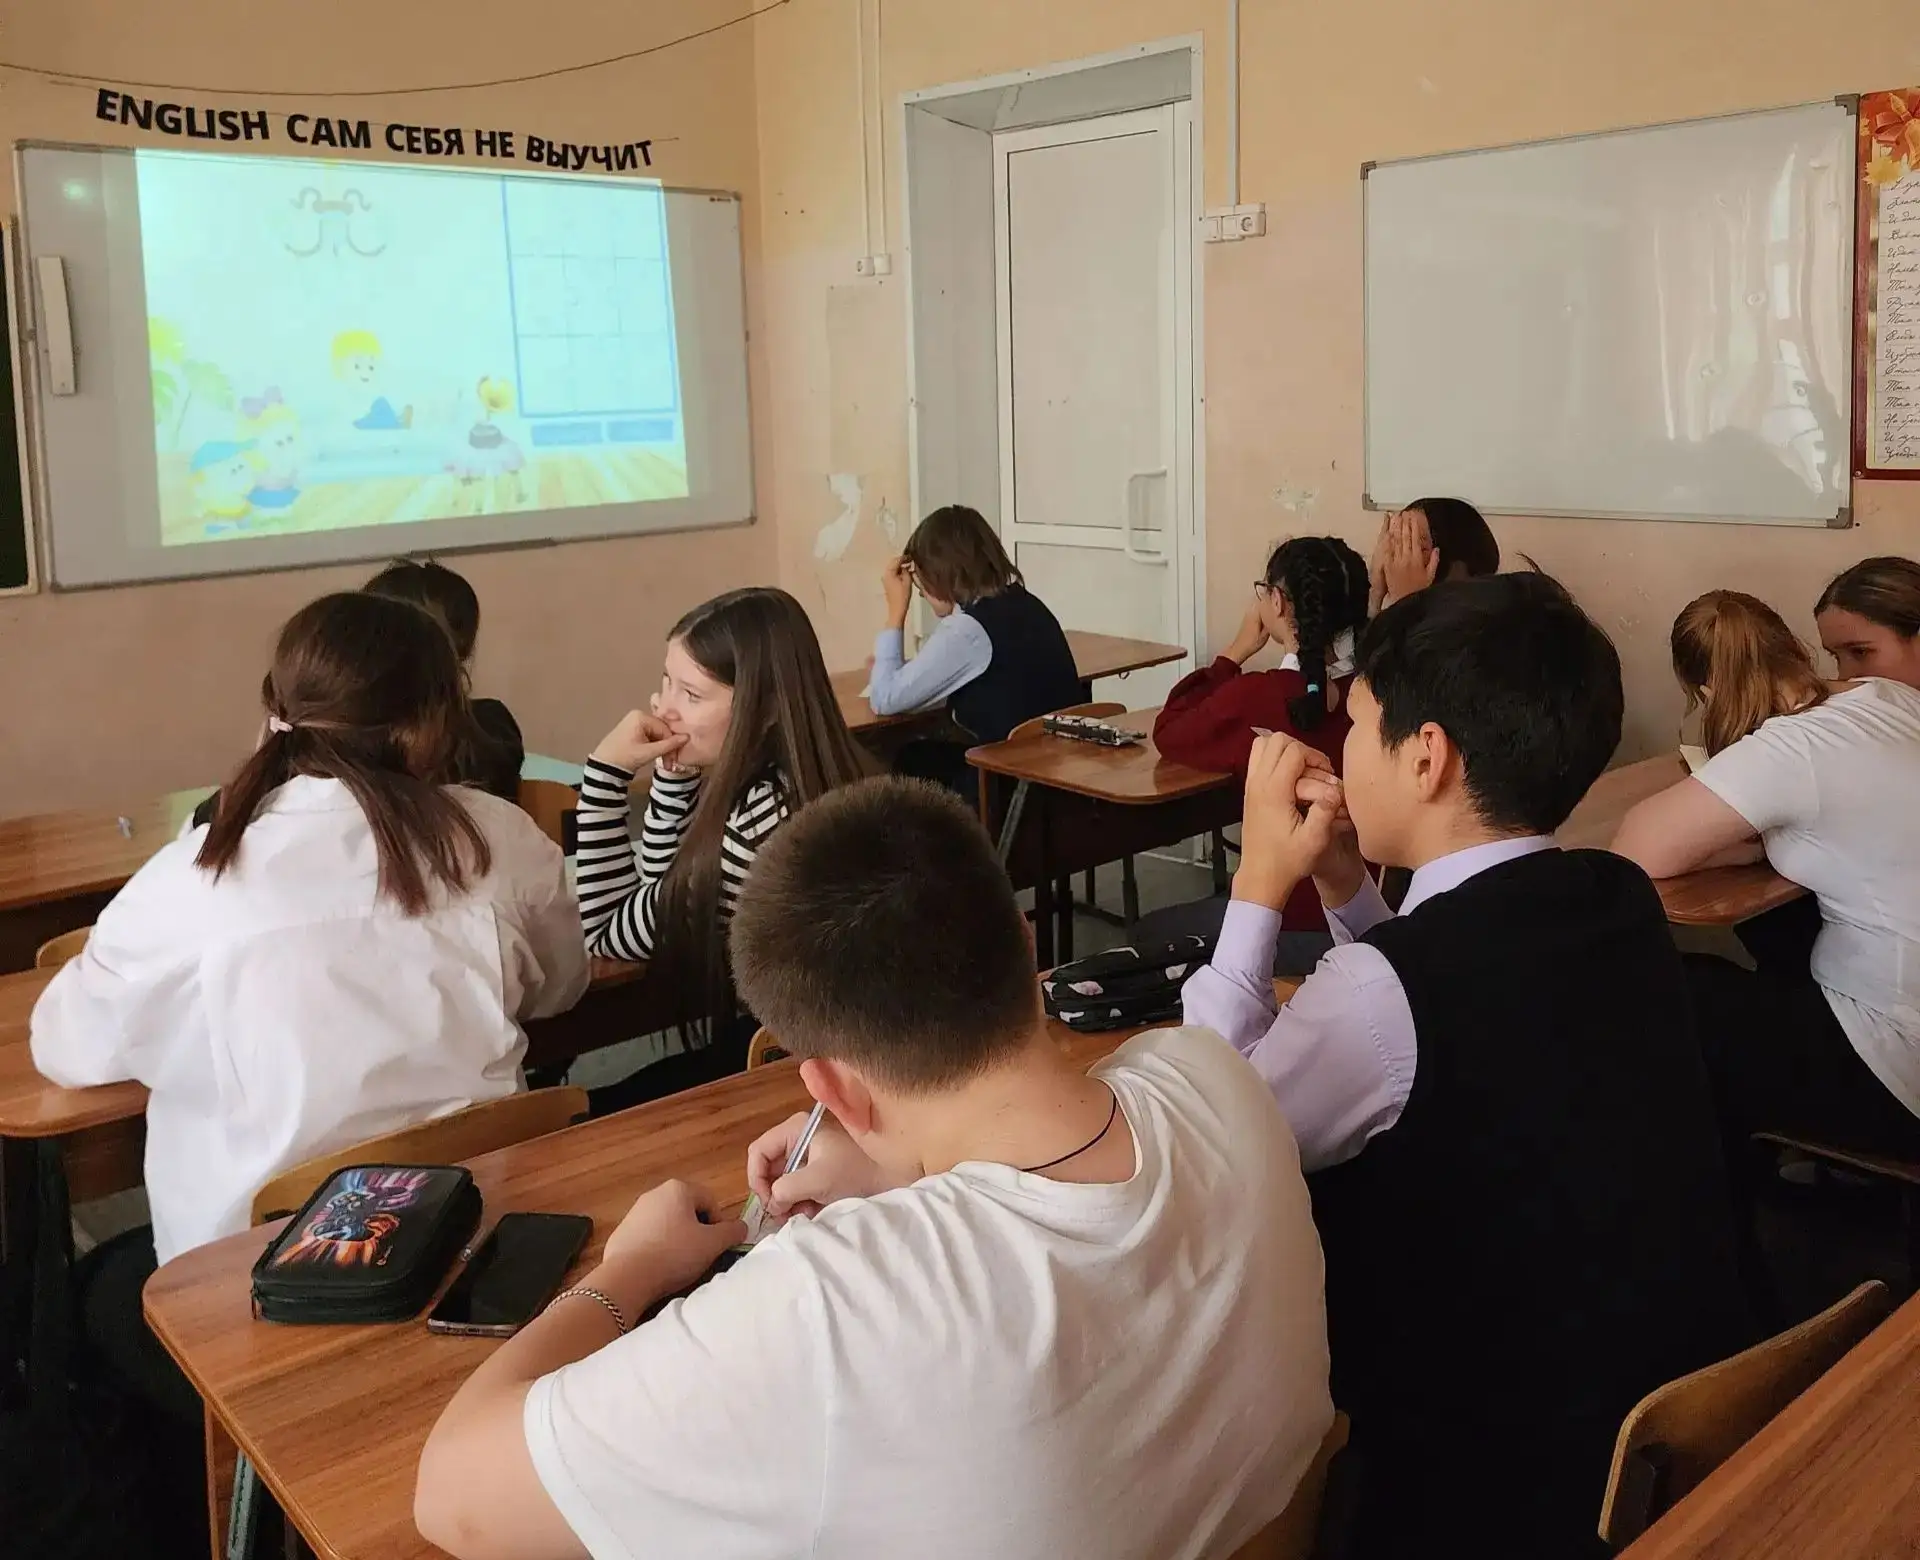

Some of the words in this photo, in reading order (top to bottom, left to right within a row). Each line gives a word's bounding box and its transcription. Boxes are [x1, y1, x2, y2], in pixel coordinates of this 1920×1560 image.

[96, 88, 270, 141] ENGLISH
[286, 113, 372, 149] САМ
[385, 123, 465, 155] СЕБЯ
[475, 129, 515, 158] НЕ
[525, 135, 652, 172] ВЫУЧИТ
